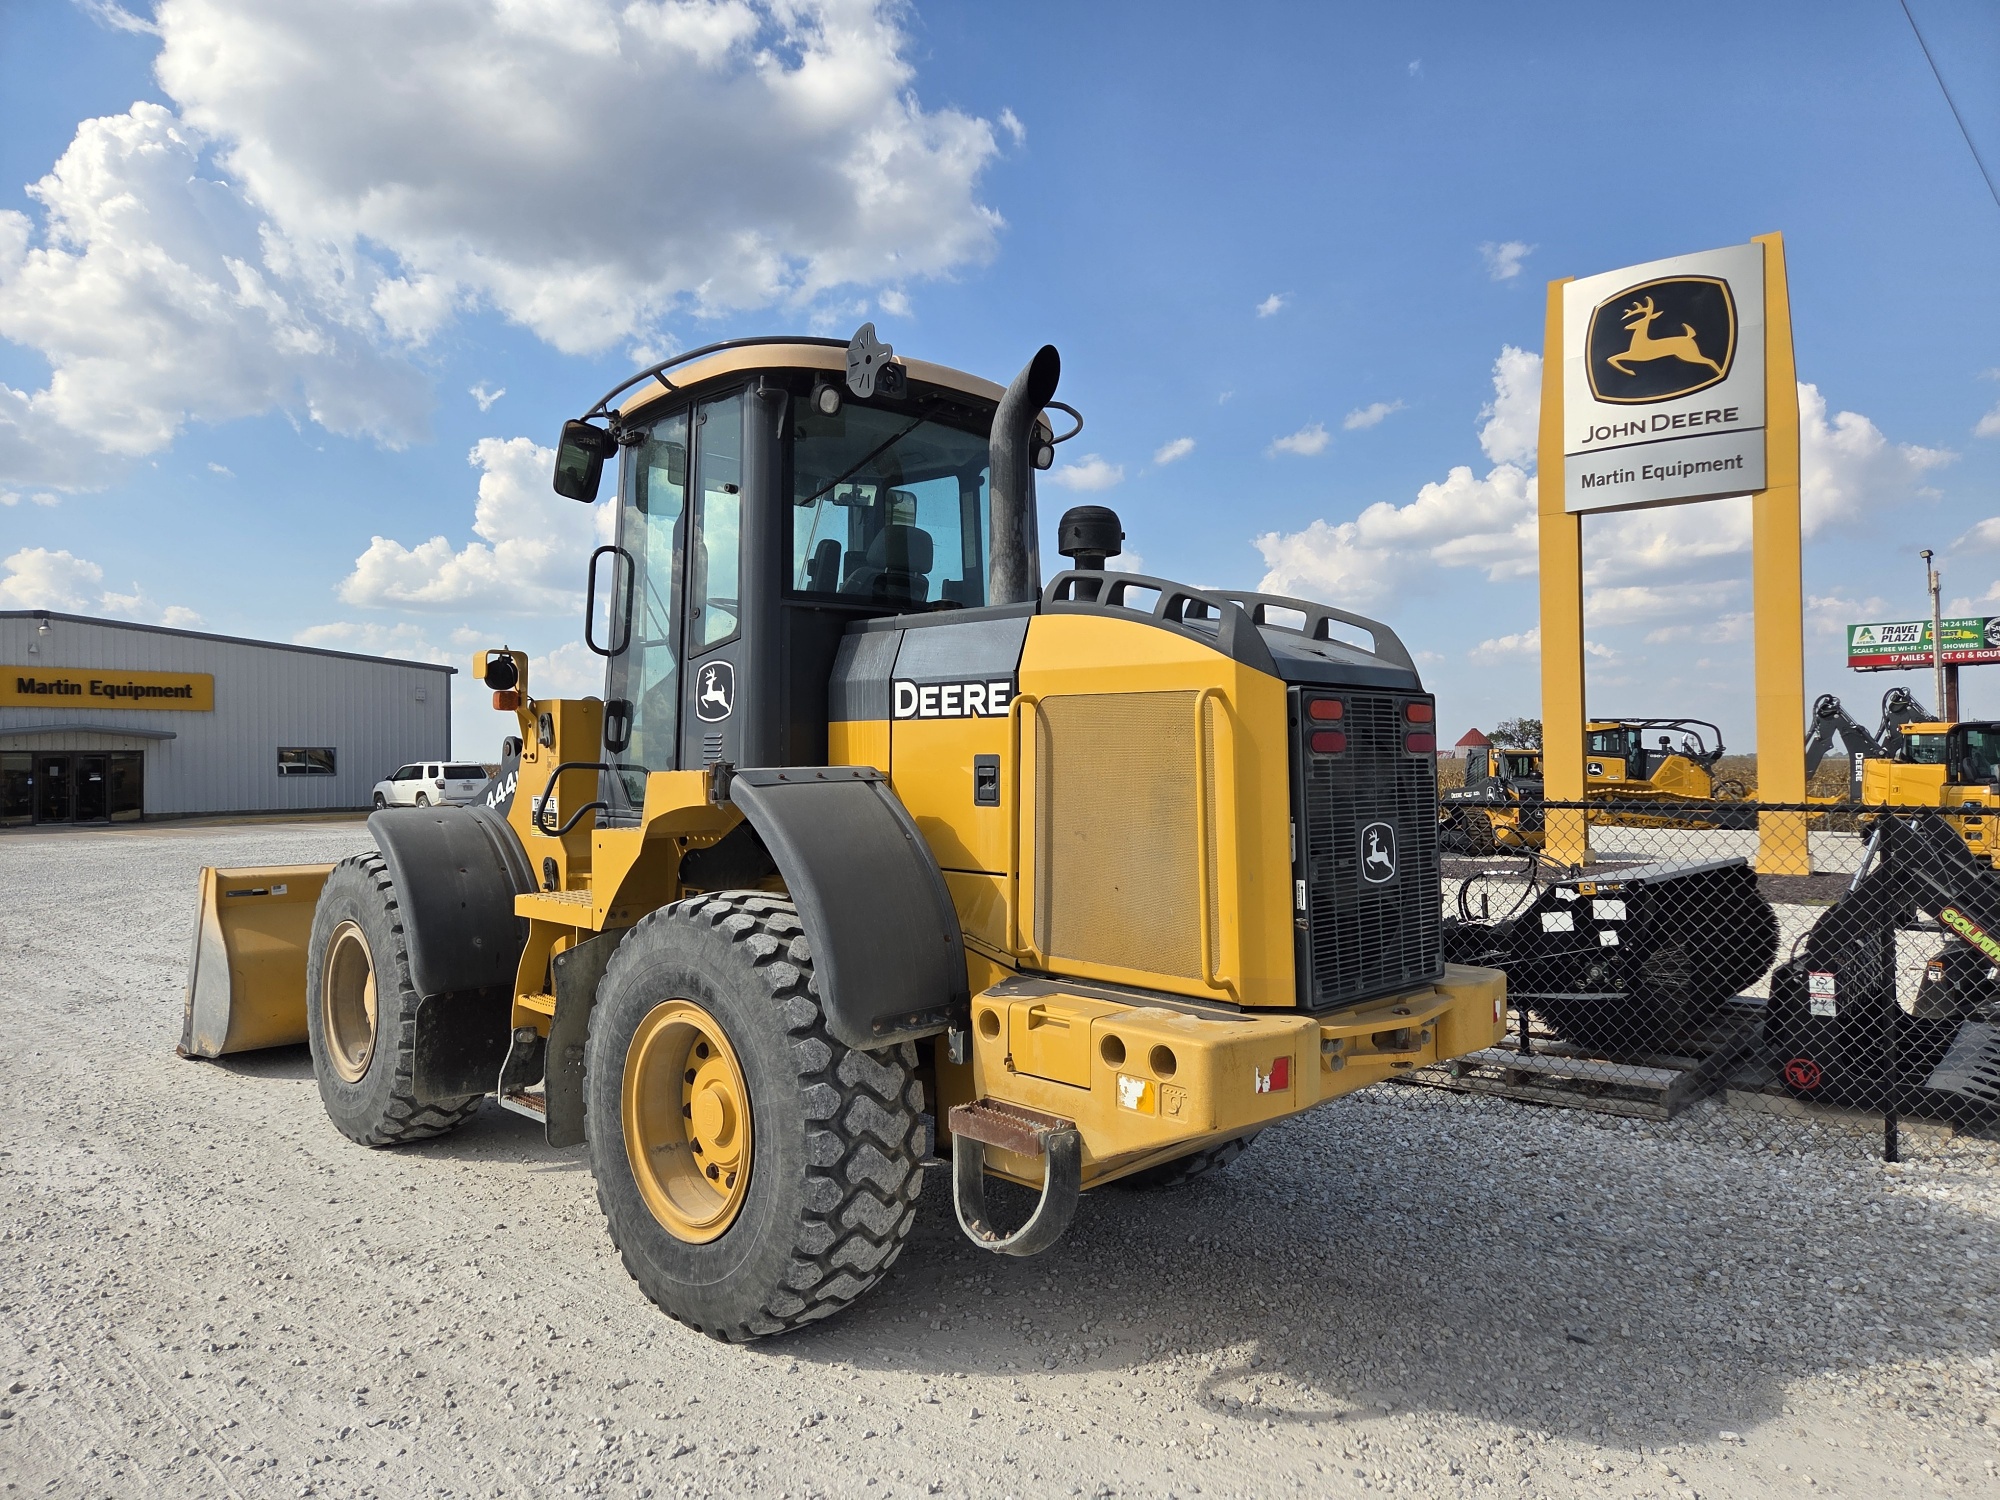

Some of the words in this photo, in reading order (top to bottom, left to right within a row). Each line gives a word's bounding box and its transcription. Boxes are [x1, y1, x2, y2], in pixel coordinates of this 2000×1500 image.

[1582, 420, 1646, 443] JOHN
[1651, 407, 1739, 432] DEERE
[1581, 468, 1635, 489] Martin
[1642, 454, 1743, 481] Equipment
[1881, 625, 1919, 635] TRAVEL
[1881, 633, 1915, 643] PLAZA
[1901, 654, 1926, 662] MILES
[1967, 651, 1975, 659] &
[17, 677, 82, 695] Martin
[90, 680, 192, 700] Equipment
[894, 681, 1010, 718] DEERE
[1855, 753, 1863, 781] DEERE
